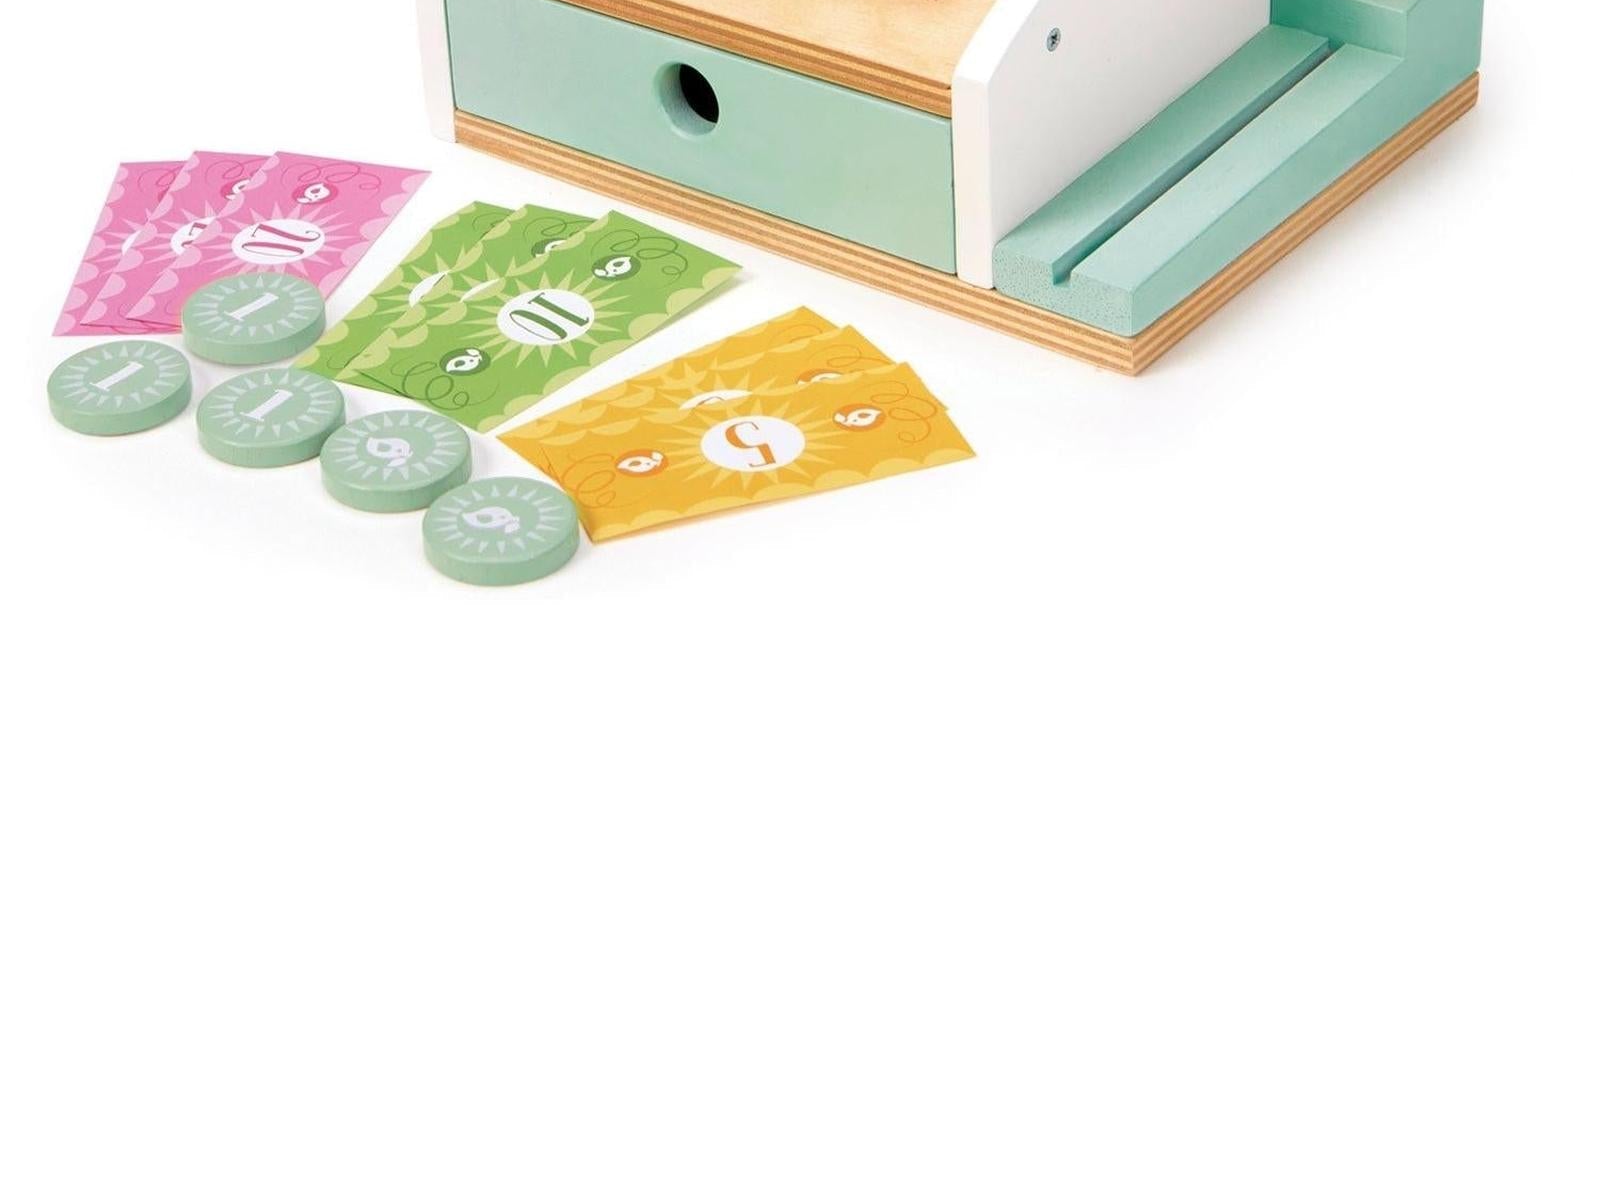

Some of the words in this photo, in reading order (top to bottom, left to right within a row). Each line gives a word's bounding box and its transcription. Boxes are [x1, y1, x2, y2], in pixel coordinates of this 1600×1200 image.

[223, 292, 280, 322] 1
[508, 291, 591, 342] 10
[88, 360, 145, 392] 1
[239, 388, 294, 422] 1
[724, 420, 777, 468] 5
